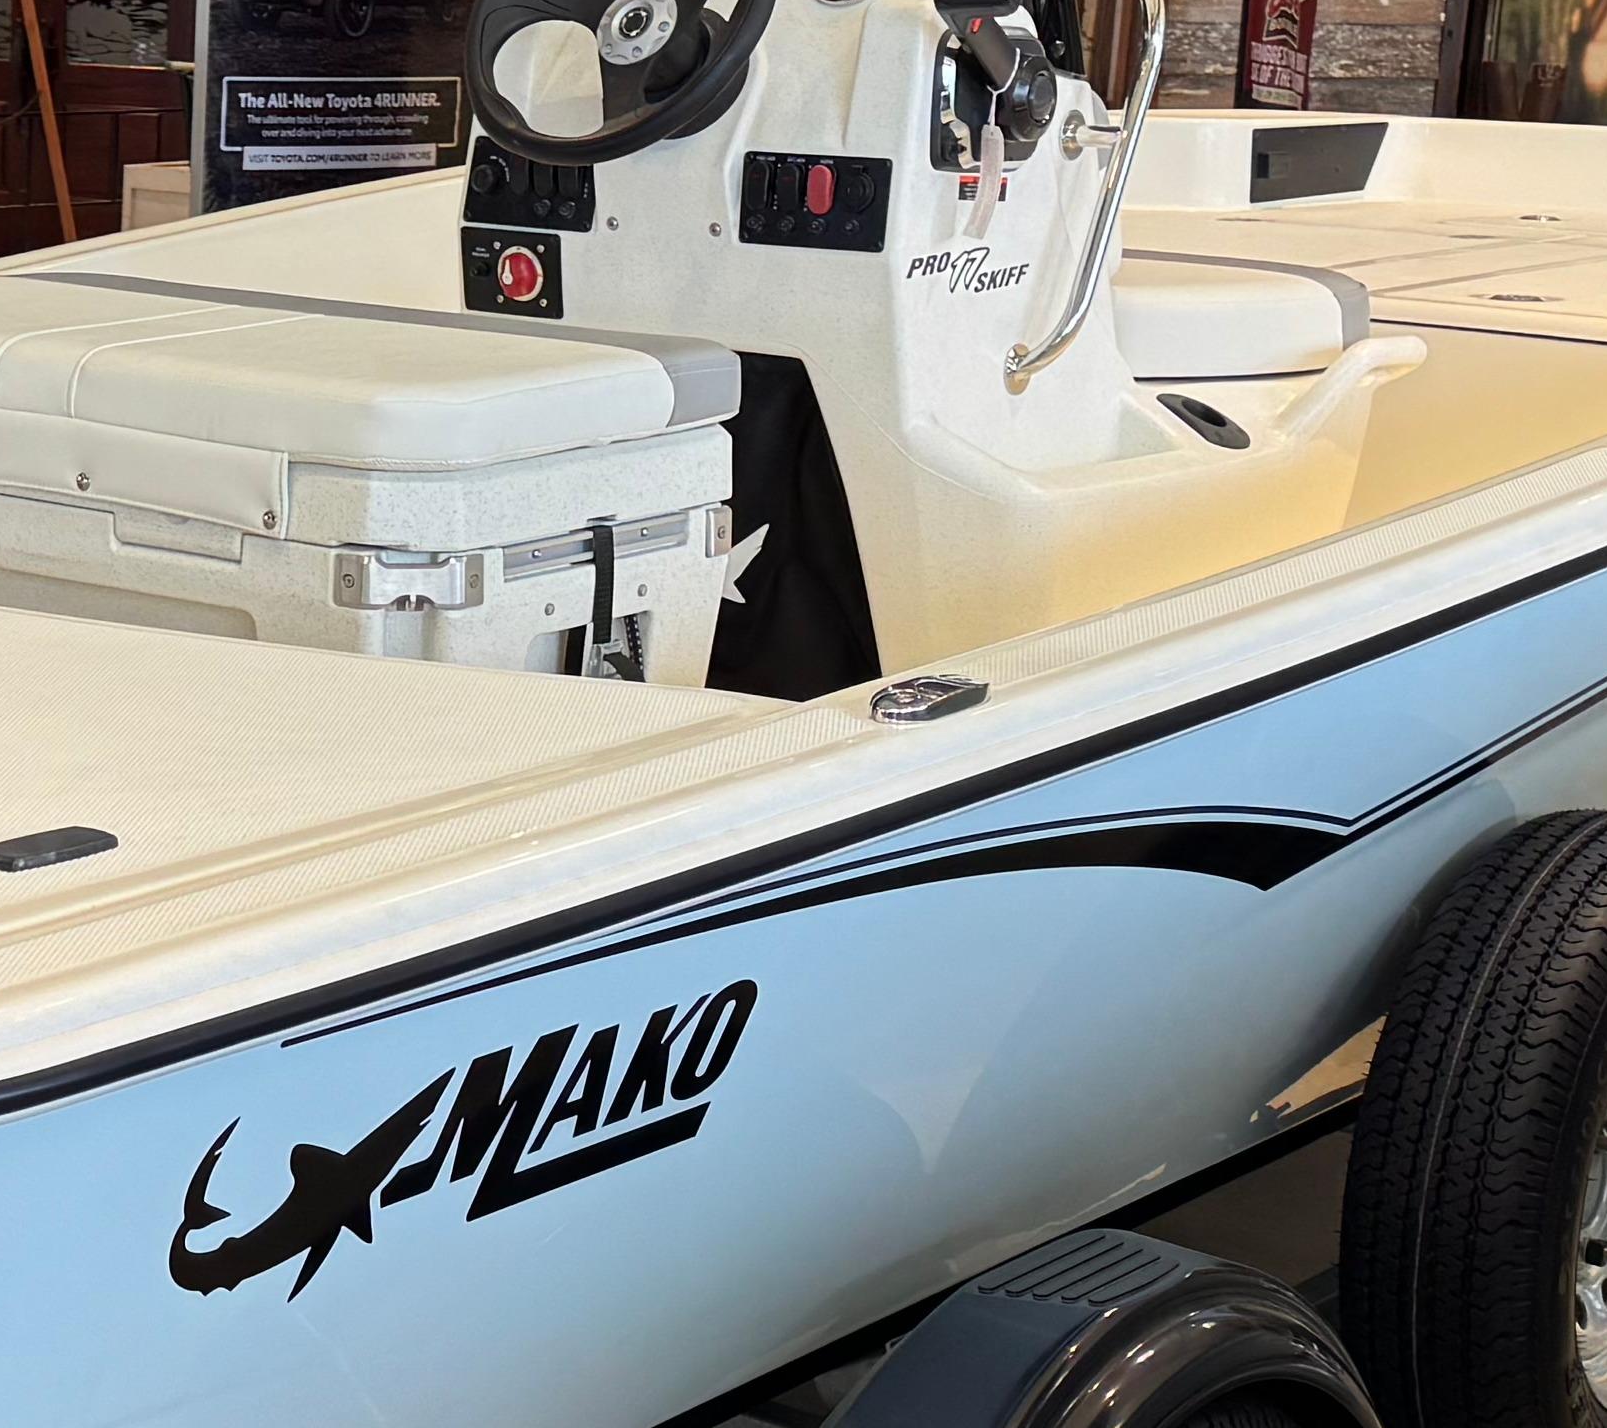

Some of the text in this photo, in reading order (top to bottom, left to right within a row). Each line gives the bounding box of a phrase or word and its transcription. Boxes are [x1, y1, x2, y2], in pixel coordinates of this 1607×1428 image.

[238, 92, 442, 112] The All-New Toyota 4RUNNER.
[906, 246, 1030, 294] PRO 17 SKIFF
[380, 978, 759, 1223] MAKO
